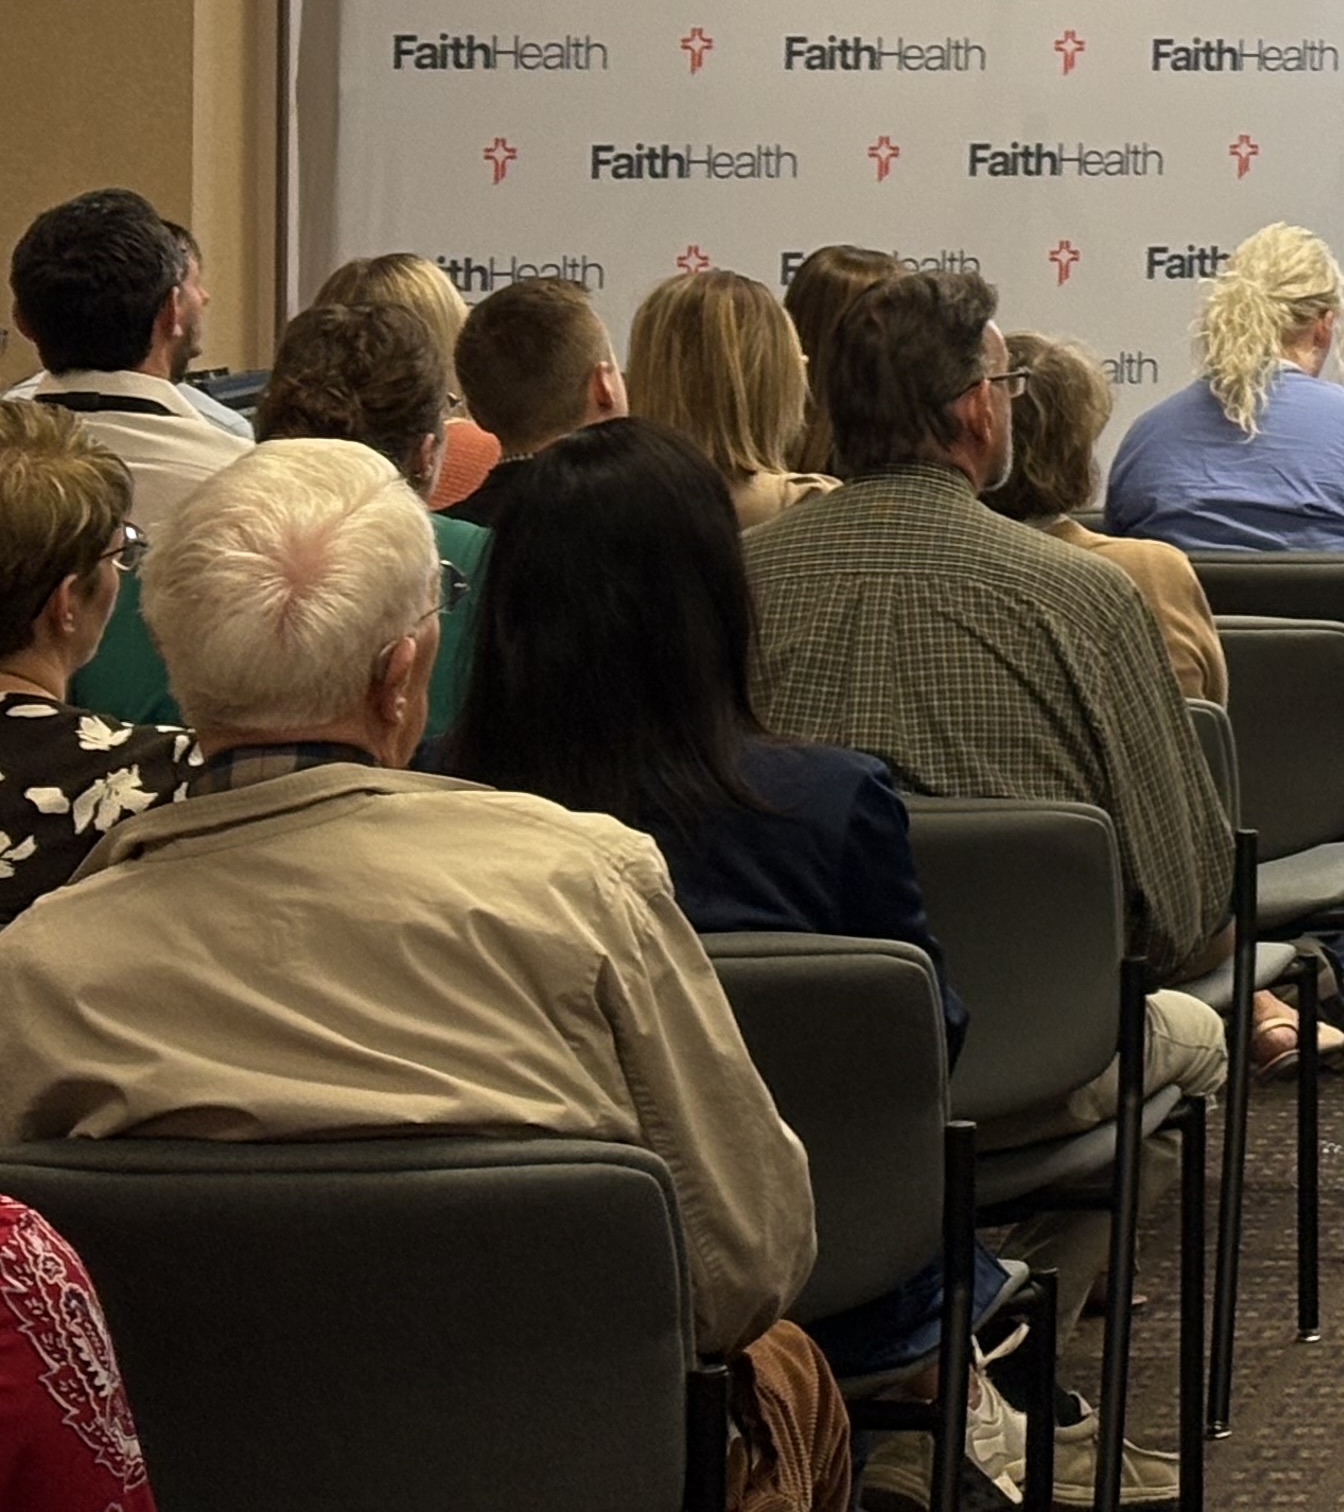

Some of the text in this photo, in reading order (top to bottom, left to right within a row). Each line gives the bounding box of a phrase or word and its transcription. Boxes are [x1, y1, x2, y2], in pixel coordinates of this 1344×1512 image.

[393, 32, 608, 72] FaithHealth
[784, 34, 986, 73] FaithHealth
[1151, 37, 1339, 74] FaithHealth
[590, 142, 797, 181] FaithHealth
[968, 141, 1164, 179] FaithHealth
